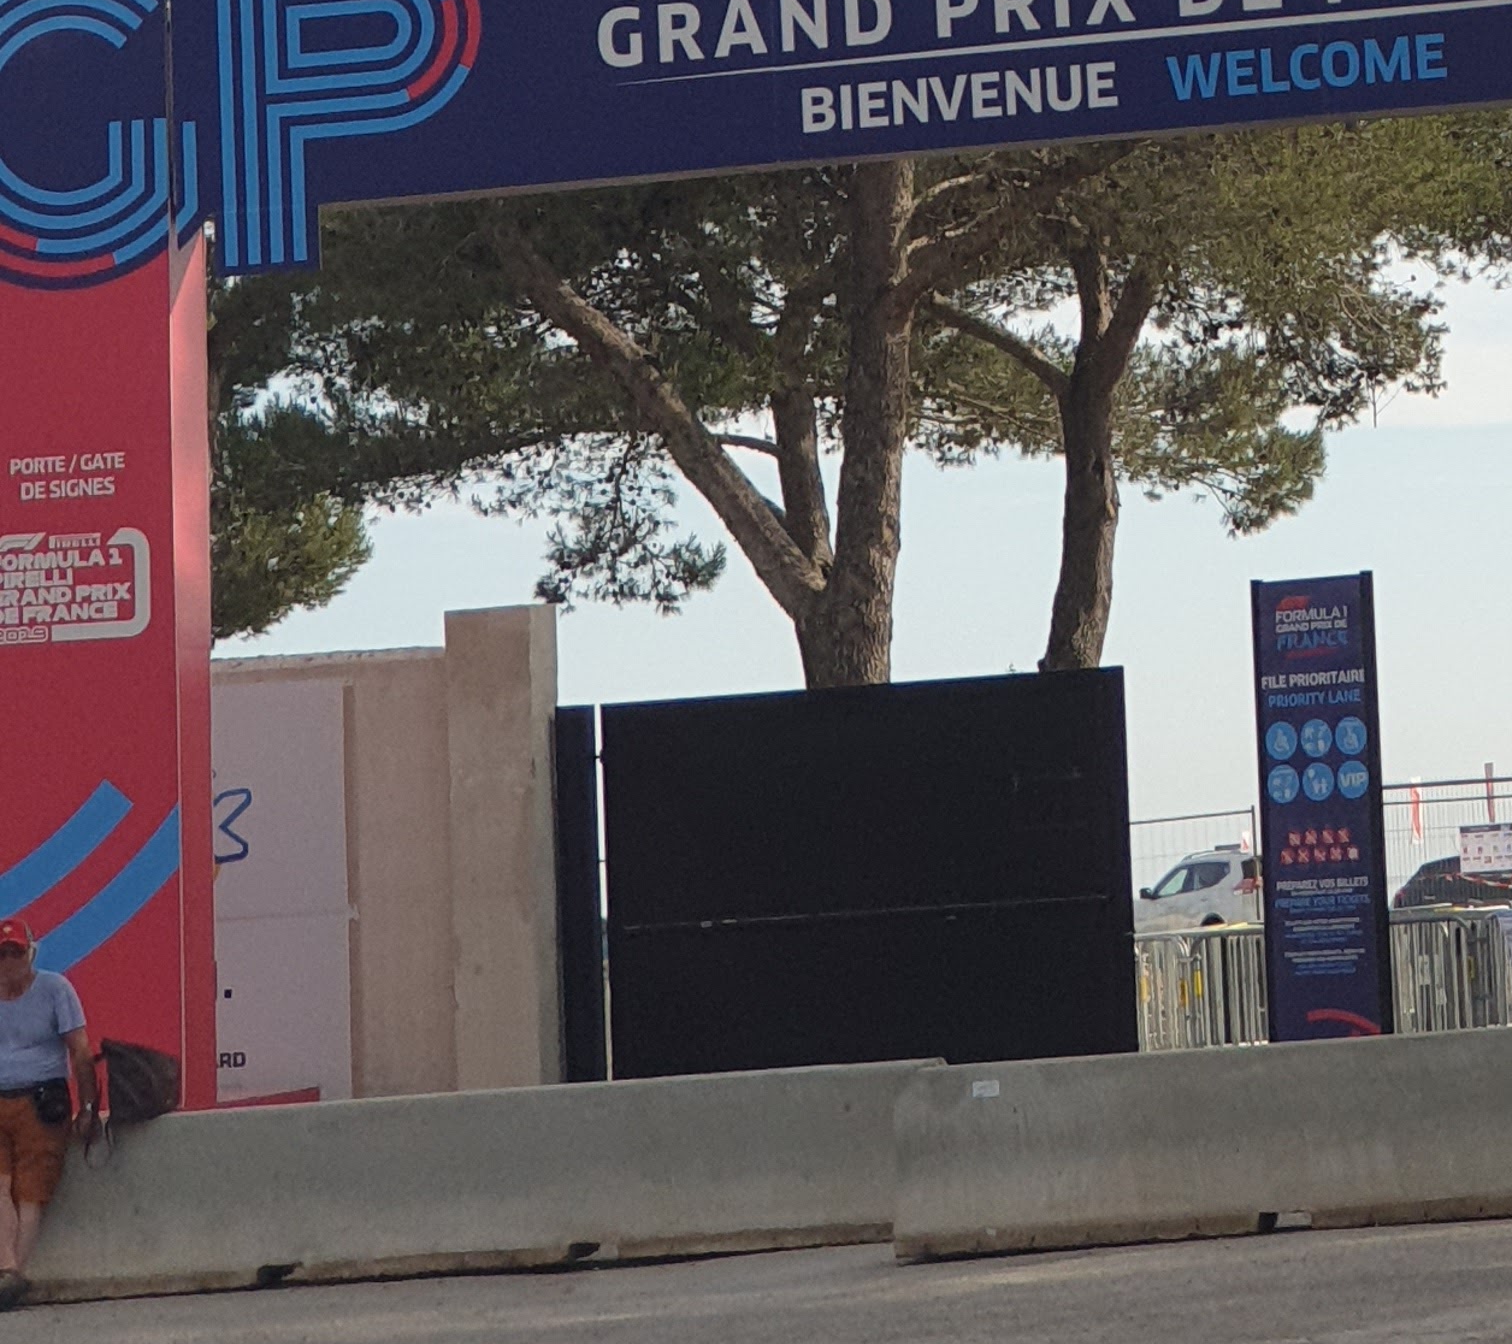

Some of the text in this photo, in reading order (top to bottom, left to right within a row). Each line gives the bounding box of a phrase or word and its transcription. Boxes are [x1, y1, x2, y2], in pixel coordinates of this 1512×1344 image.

[801, 33, 1448, 134] BIENVENUE WELCOME
[10, 456, 66, 476] PORTE
[80, 452, 126, 471] GATE
[20, 476, 116, 501] DE SIGNES
[0, 547, 123, 572] ORMULA 1
[75, 582, 131, 603] PRIX
[22, 601, 119, 624] FRANCE
[1275, 606, 1341, 624] FORMULA
[1261, 674, 1287, 690] FILE
[1268, 688, 1361, 708] PRIORITY LANE
[1340, 771, 1367, 788] VIP
[216, 1051, 247, 1068] RD
